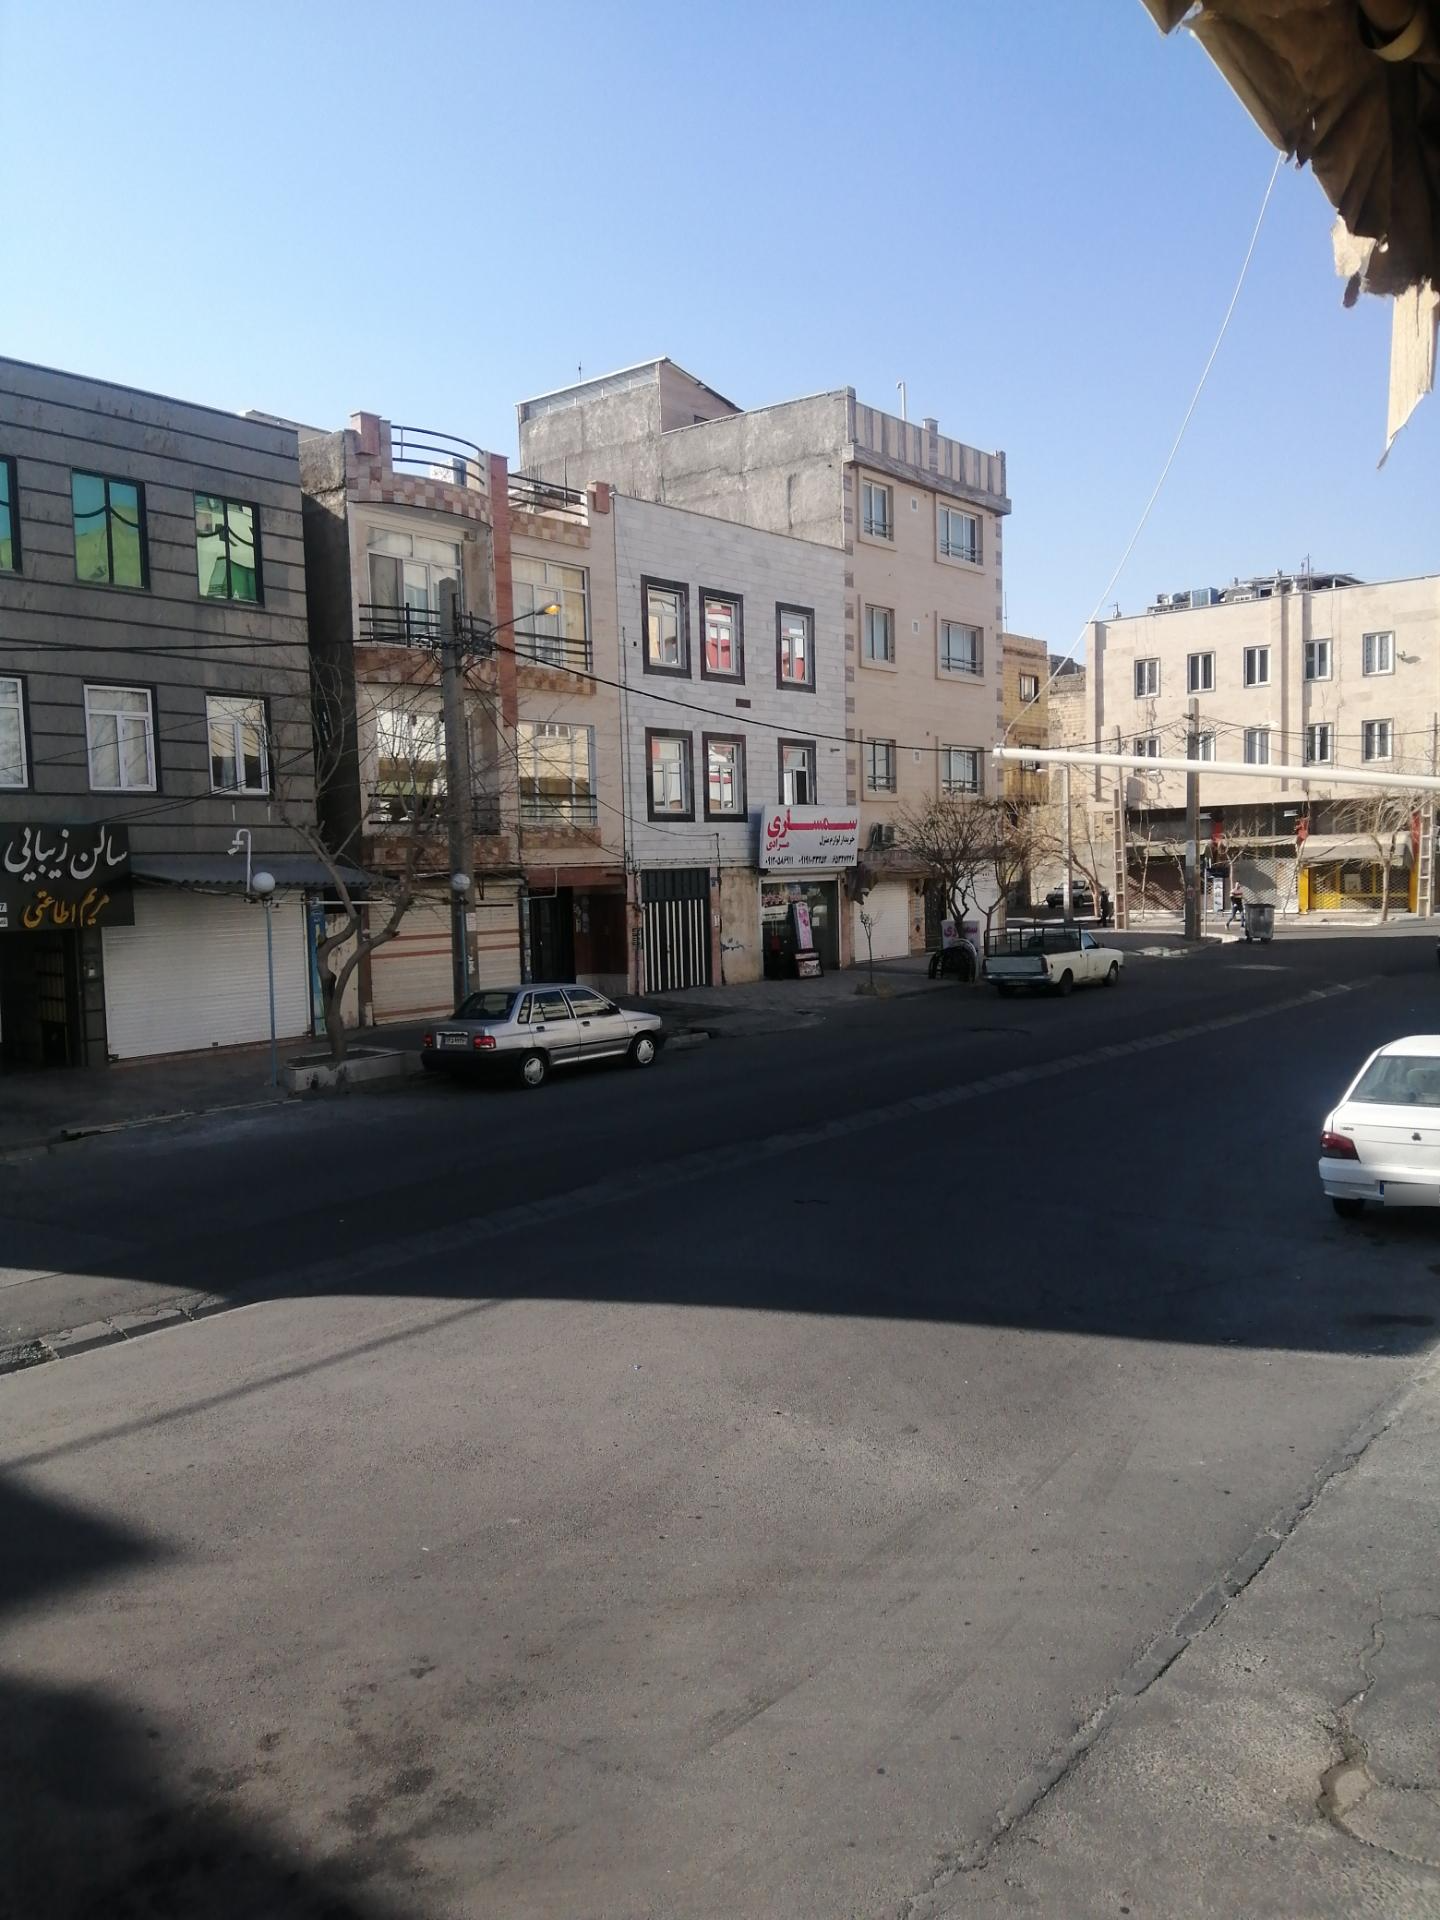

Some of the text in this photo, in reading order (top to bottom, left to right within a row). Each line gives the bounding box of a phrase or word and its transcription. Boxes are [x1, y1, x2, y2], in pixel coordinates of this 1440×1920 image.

[767, 808, 858, 838] سمساری
[766, 838, 790, 851] مرادی
[830, 834, 841, 846] لوازم
[4, 825, 128, 882] سالن زیبایی
[80, 887, 110, 927] مریم
[944, 926, 978, 937] سمری
